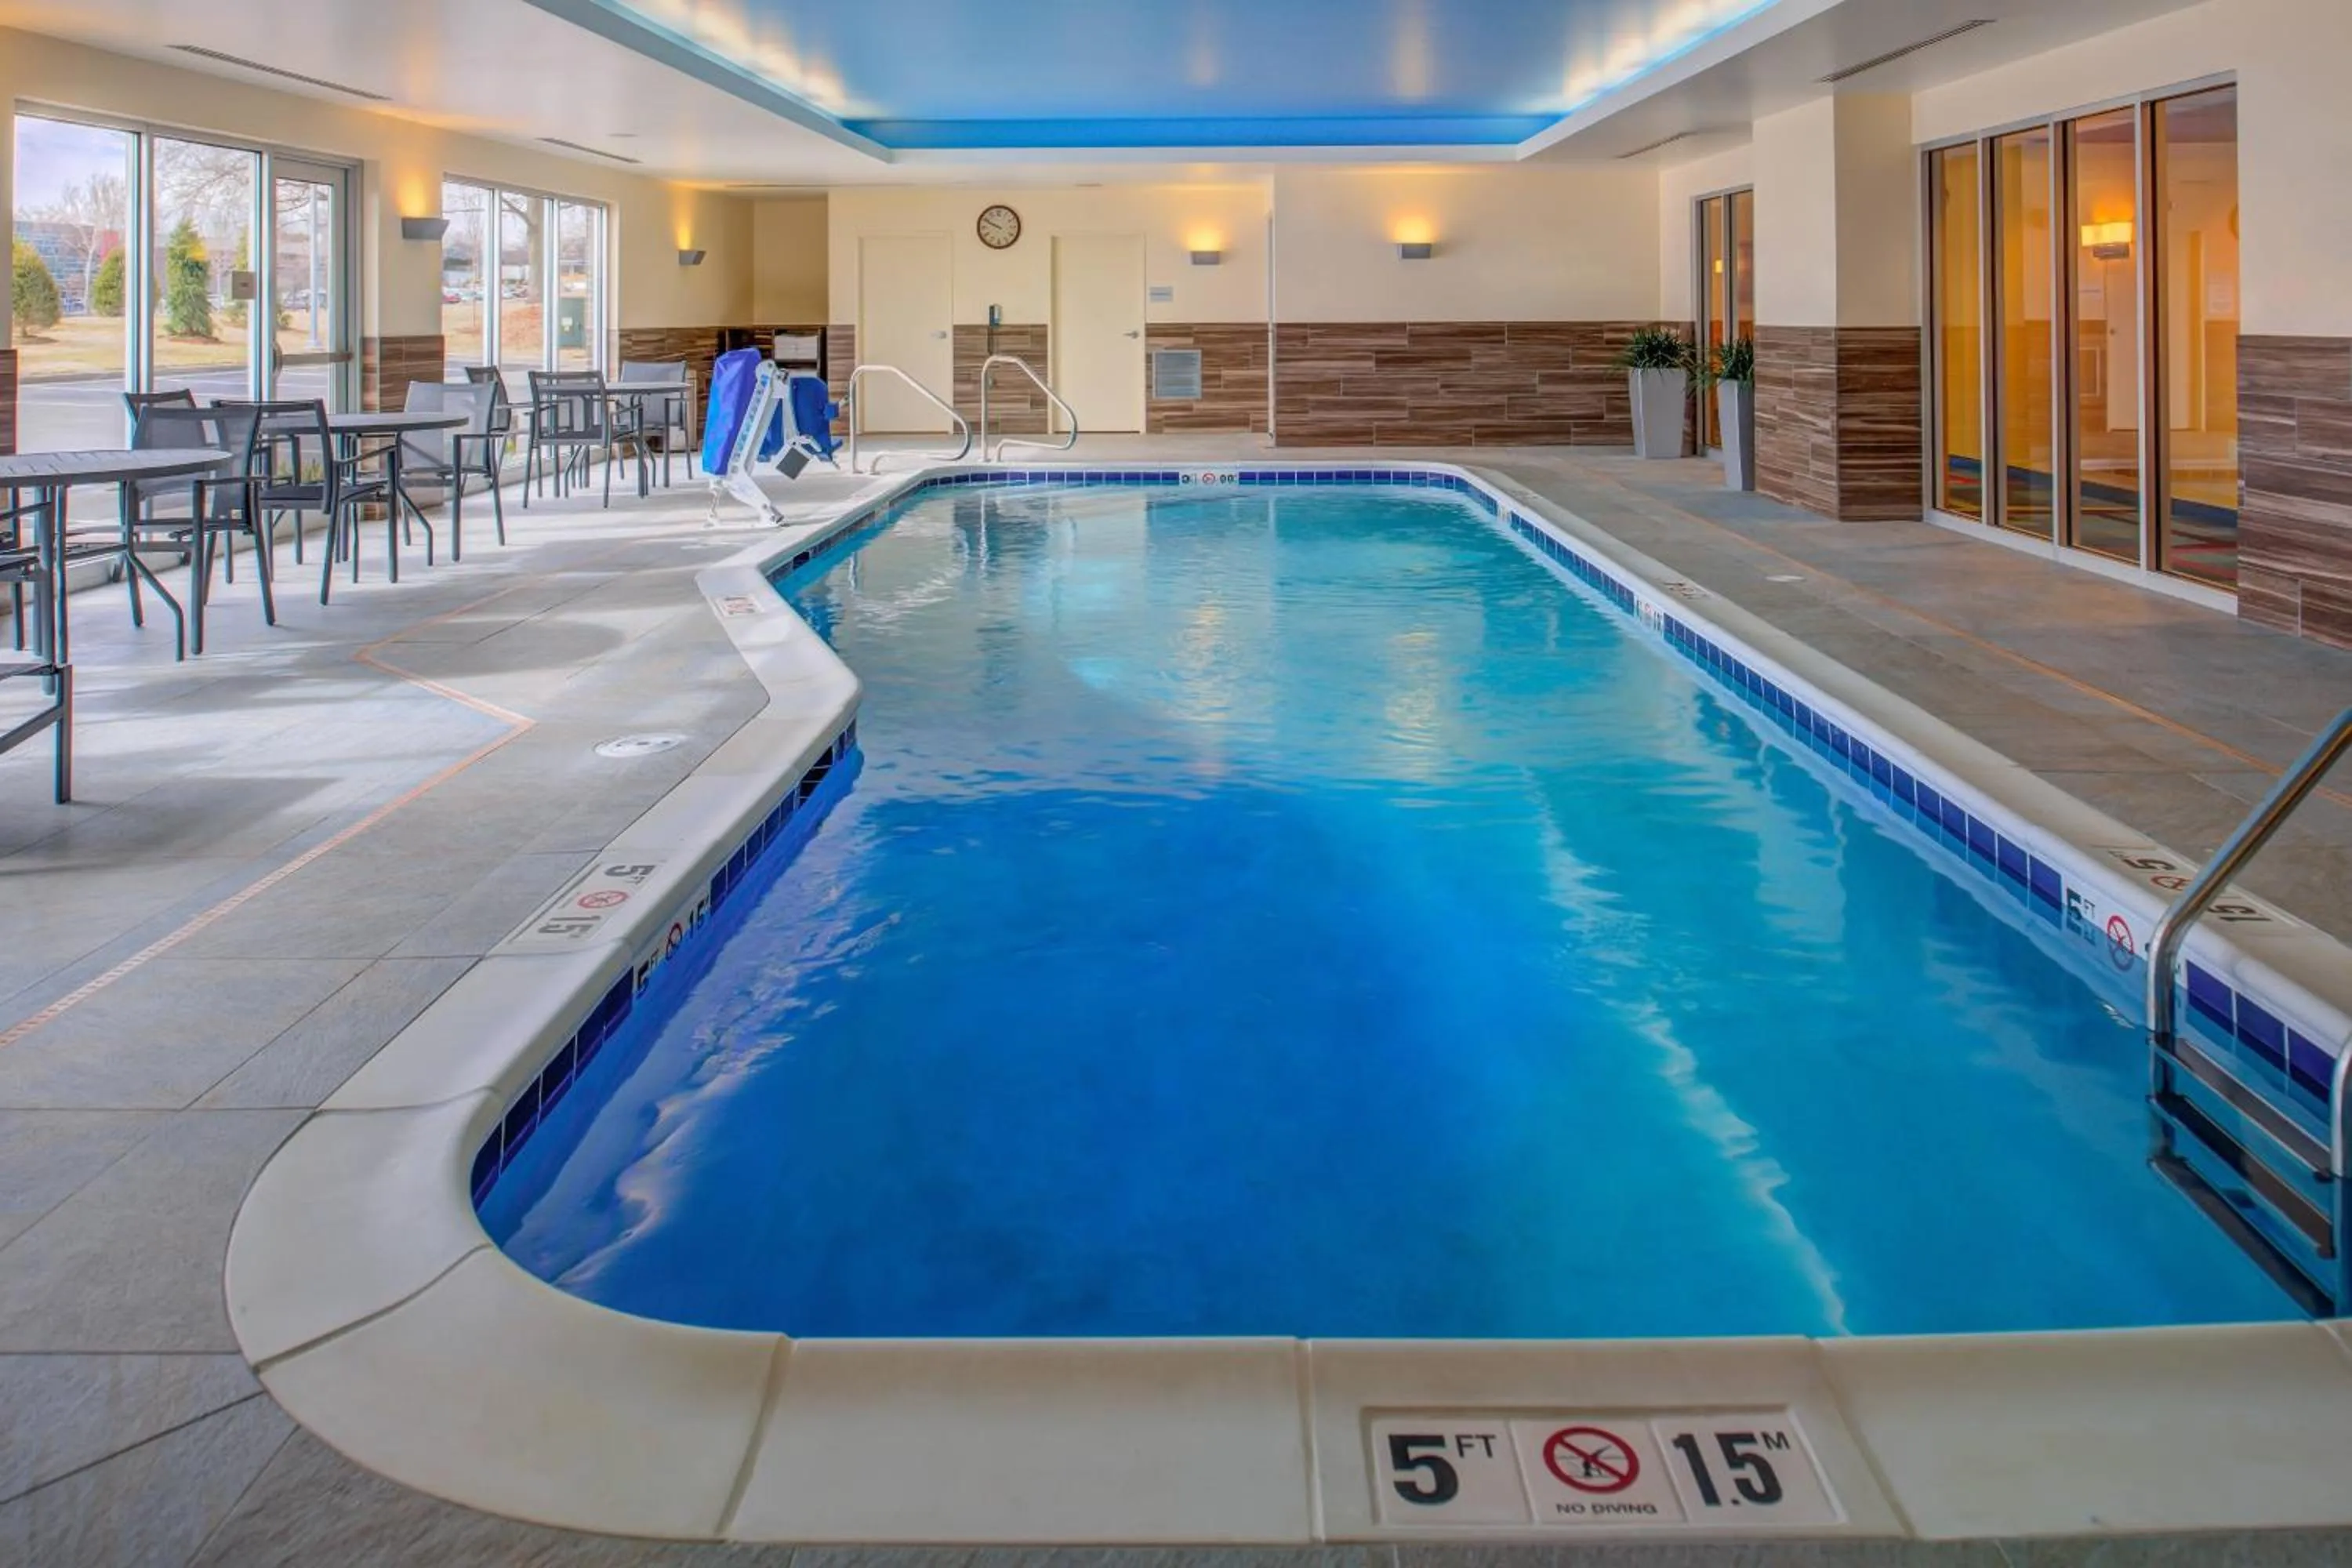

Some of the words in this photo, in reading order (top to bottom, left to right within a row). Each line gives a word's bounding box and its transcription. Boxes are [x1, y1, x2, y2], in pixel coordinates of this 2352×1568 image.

[604, 865, 655, 877] 5
[2123, 858, 2178, 871] 5
[1388, 1434, 1459, 1506] 5
[1455, 1434, 1497, 1459] FT
[1671, 1432, 1783, 1506] 1.5
[1761, 1431, 1791, 1450] M
[1555, 1502, 1587, 1515] NO
[1591, 1501, 1658, 1515] DIVING
